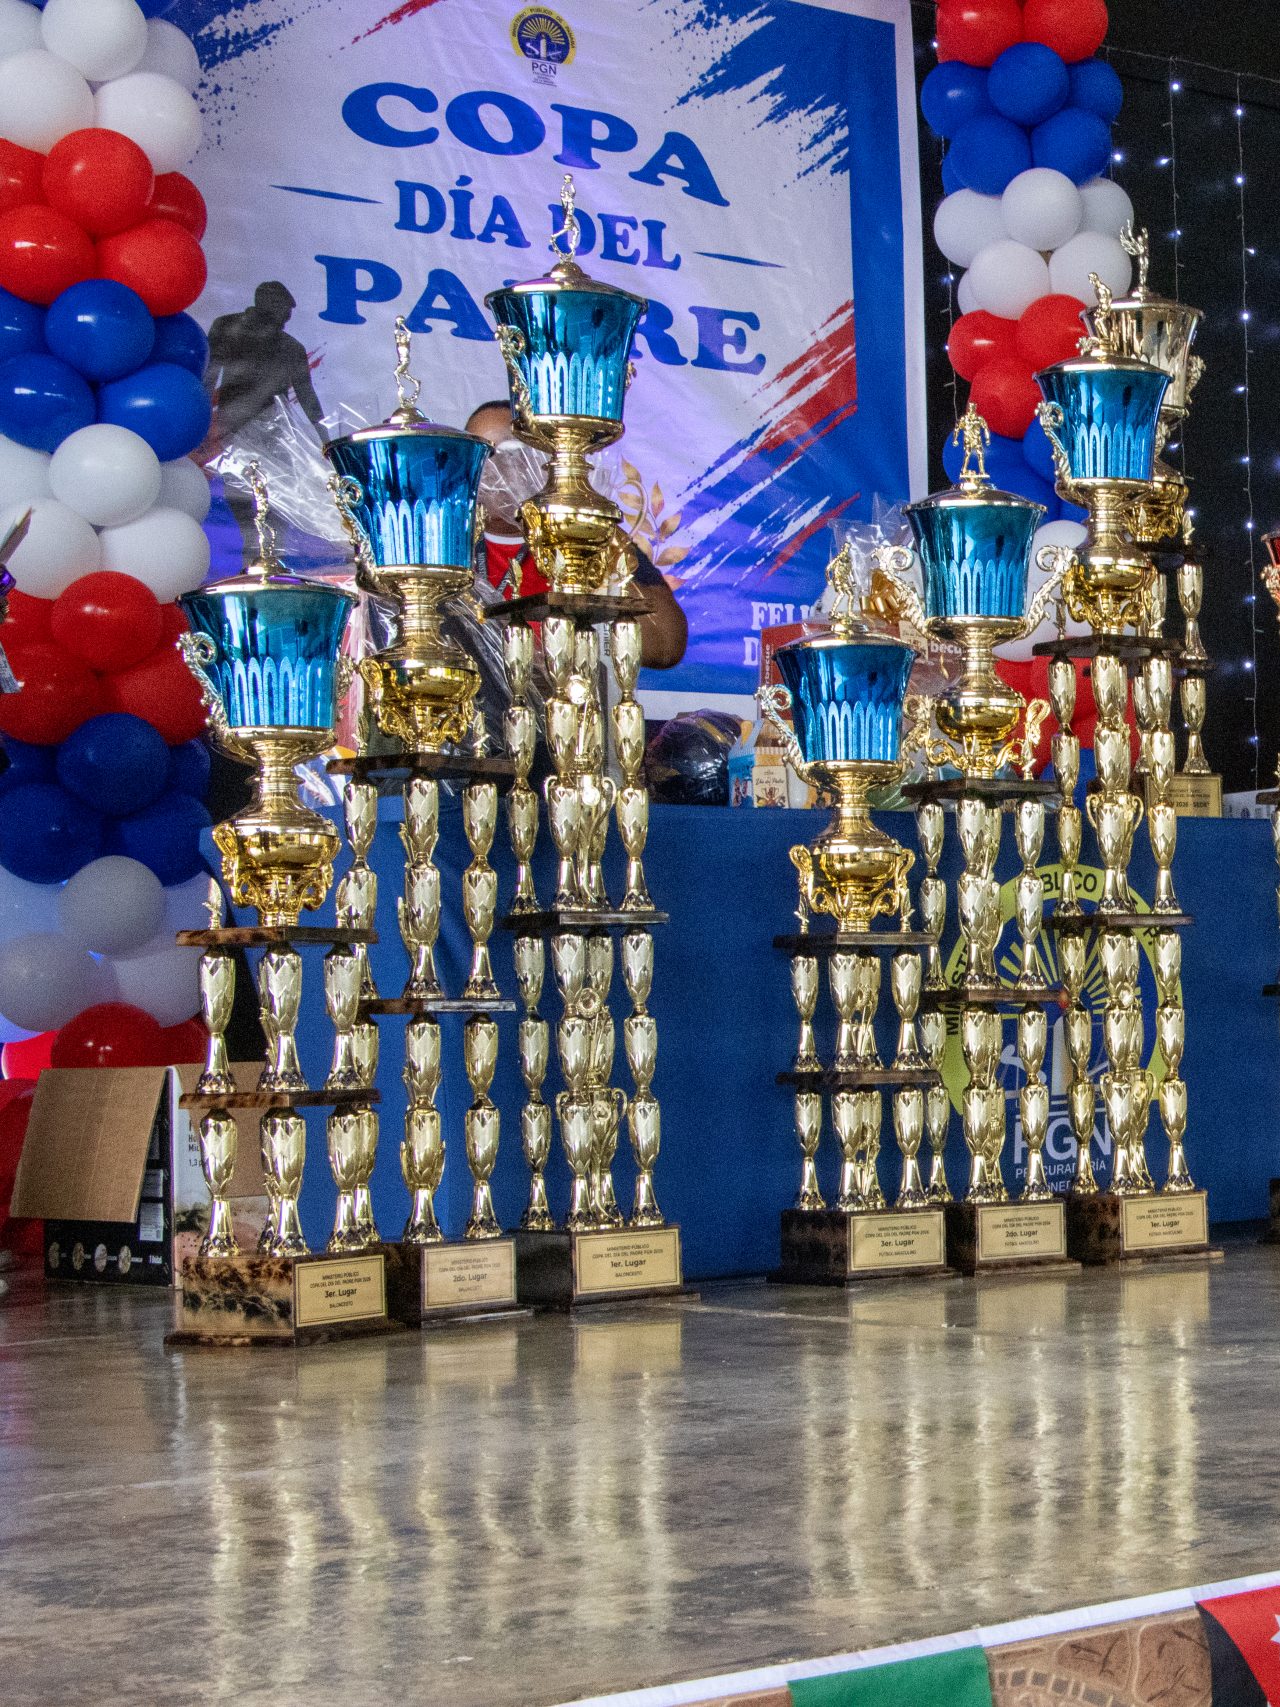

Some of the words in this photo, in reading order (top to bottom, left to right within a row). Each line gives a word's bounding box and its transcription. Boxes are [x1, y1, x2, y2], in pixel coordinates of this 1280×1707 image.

[531, 62, 557, 75] PGN
[342, 82, 730, 207] COPA
[394, 175, 531, 248] DÍA
[547, 203, 682, 271] DEL
[315, 255, 767, 375] PARE
[895, 1239, 914, 1247] Lugar
[611, 1260, 623, 1268] 1er.
[624, 1259, 646, 1267] Lugar
[453, 1274, 467, 1282] 2do.
[468, 1273, 487, 1282] Lugar
[338, 1288, 357, 1297] Lugar
